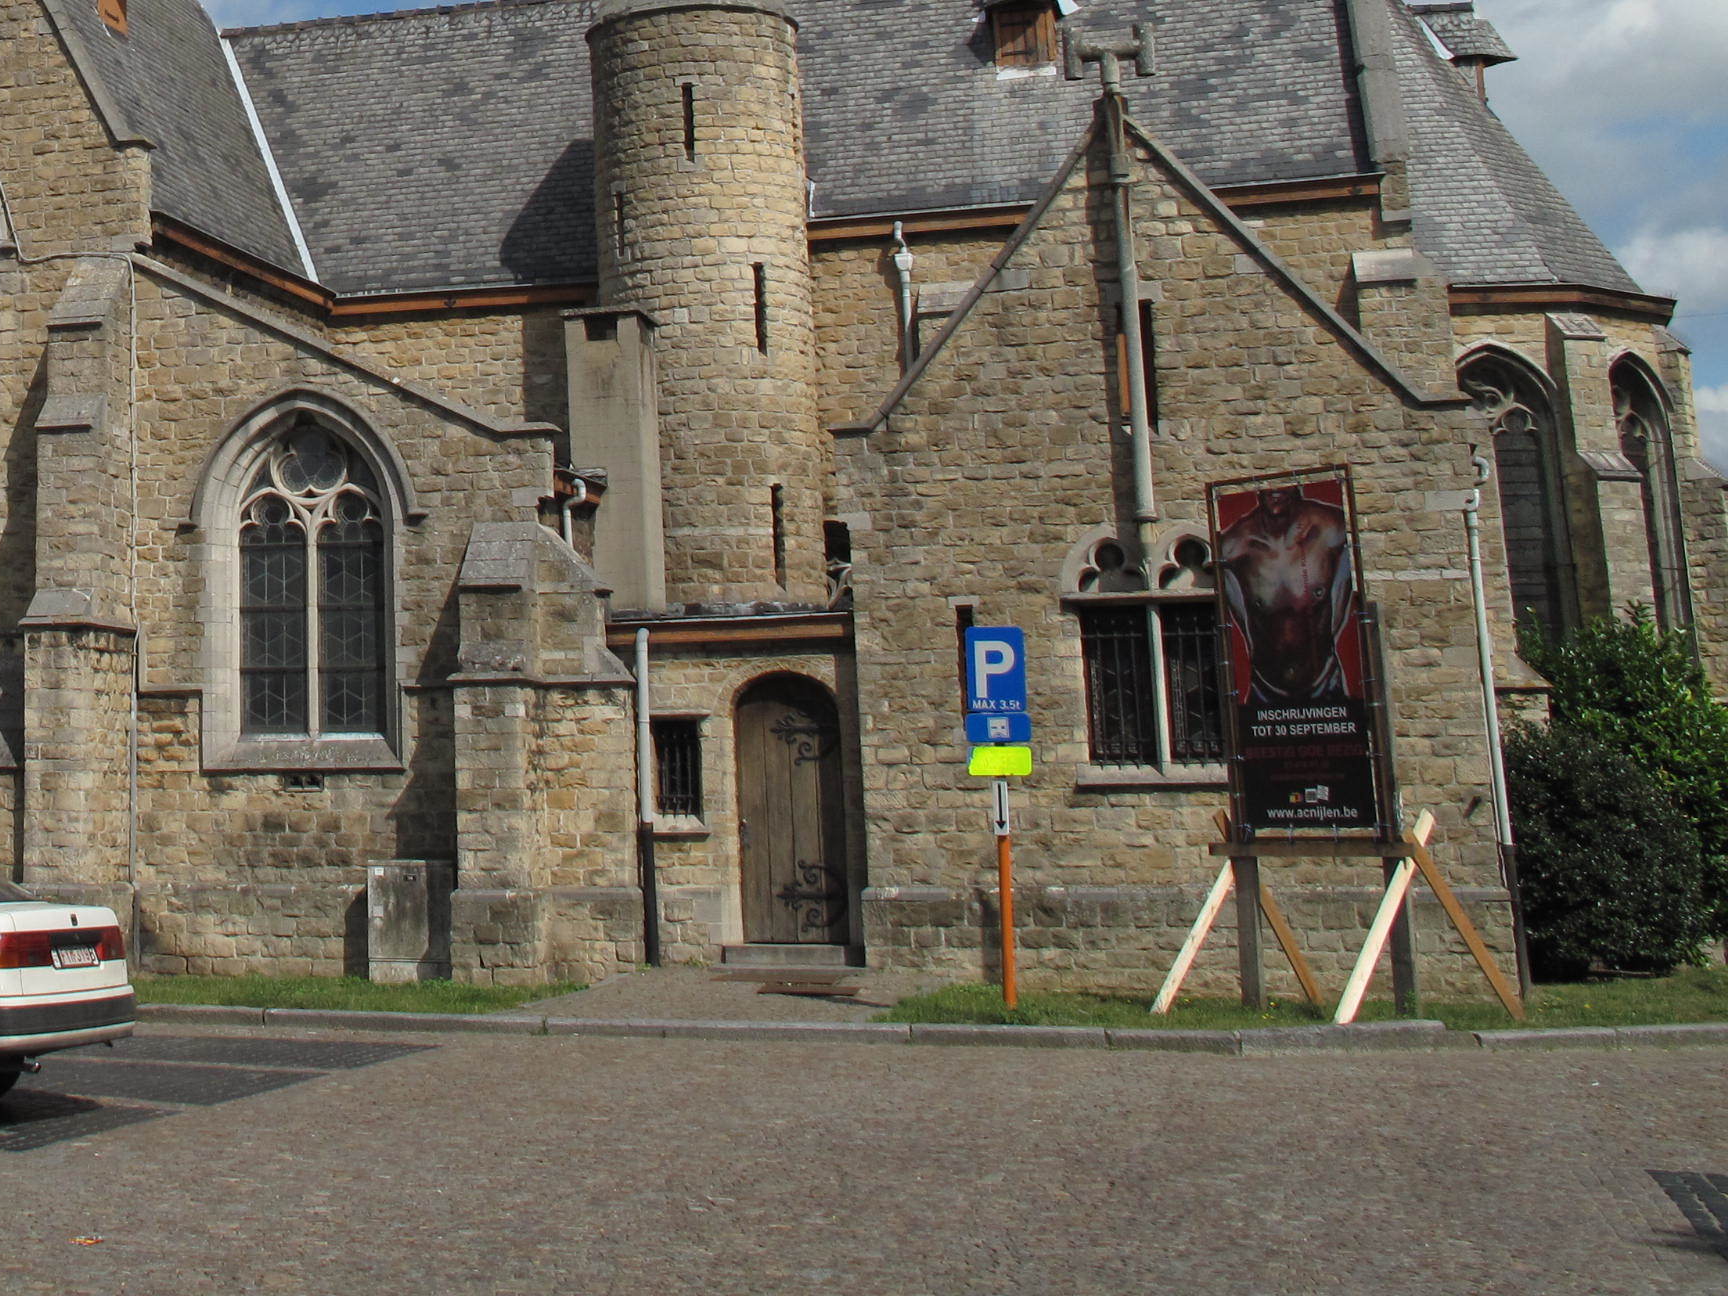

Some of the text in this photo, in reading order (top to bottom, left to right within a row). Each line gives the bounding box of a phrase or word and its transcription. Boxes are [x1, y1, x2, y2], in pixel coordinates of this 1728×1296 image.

[974, 640, 1015, 699] P
[973, 700, 1021, 710] MAX 3.5t
[1257, 706, 1347, 721] INSCHRIJVINGEN
[1252, 722, 1356, 737] TOT 30 SEPTEMBER
[1267, 806, 1358, 821] www.acnijlen.be
